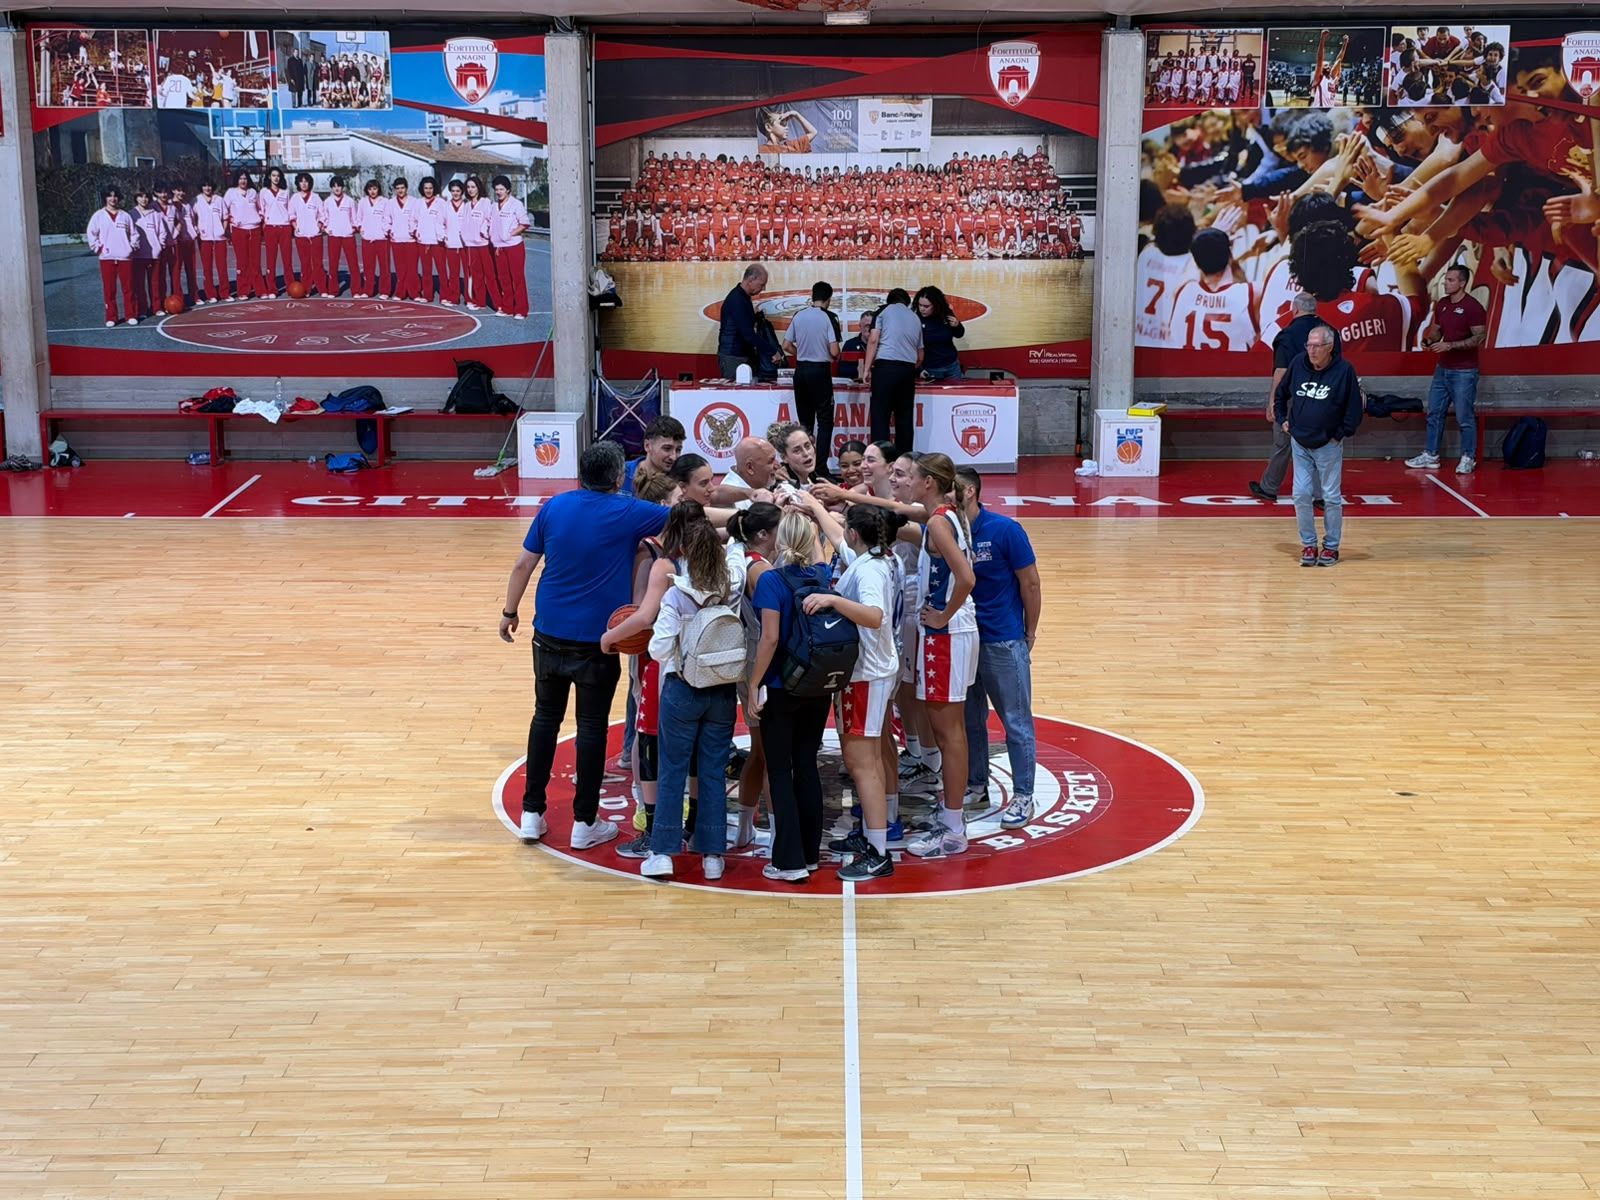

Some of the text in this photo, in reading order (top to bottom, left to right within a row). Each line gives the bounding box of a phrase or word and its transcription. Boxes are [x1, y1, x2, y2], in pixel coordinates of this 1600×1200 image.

[831, 109, 852, 121] 100
[1144, 278, 1165, 315] 7
[1195, 294, 1226, 309] BRUNI
[1183, 310, 1232, 351] 15
[1341, 318, 1387, 342] GGIERI
[291, 495, 553, 507] CITT
[976, 771, 1100, 851] BASKET
